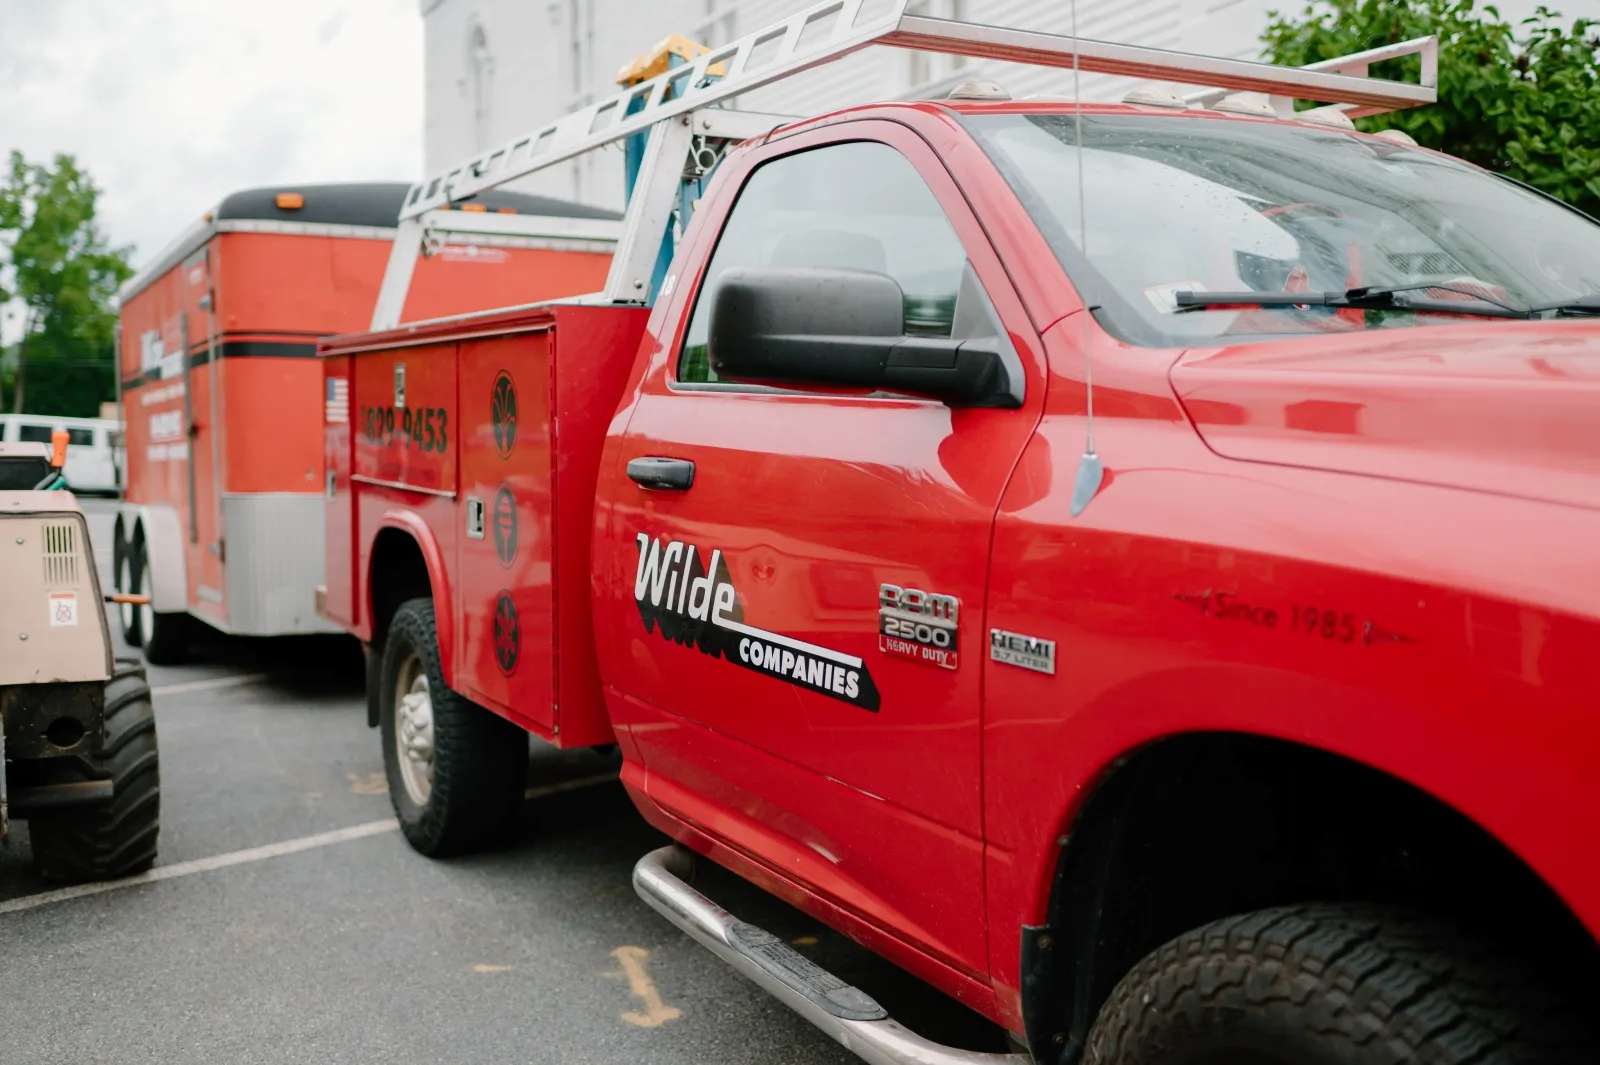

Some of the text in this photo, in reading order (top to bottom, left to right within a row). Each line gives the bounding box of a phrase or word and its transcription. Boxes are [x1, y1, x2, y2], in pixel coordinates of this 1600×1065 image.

[634, 532, 736, 629] Wilde
[885, 616, 950, 647] 2500
[1215, 592, 1356, 643] Since 1985
[886, 638, 949, 665] HEAVY DUTY
[991, 632, 1050, 659] HEMI
[739, 637, 860, 699] COMPANIES
[1014, 655, 1049, 670] LITER
